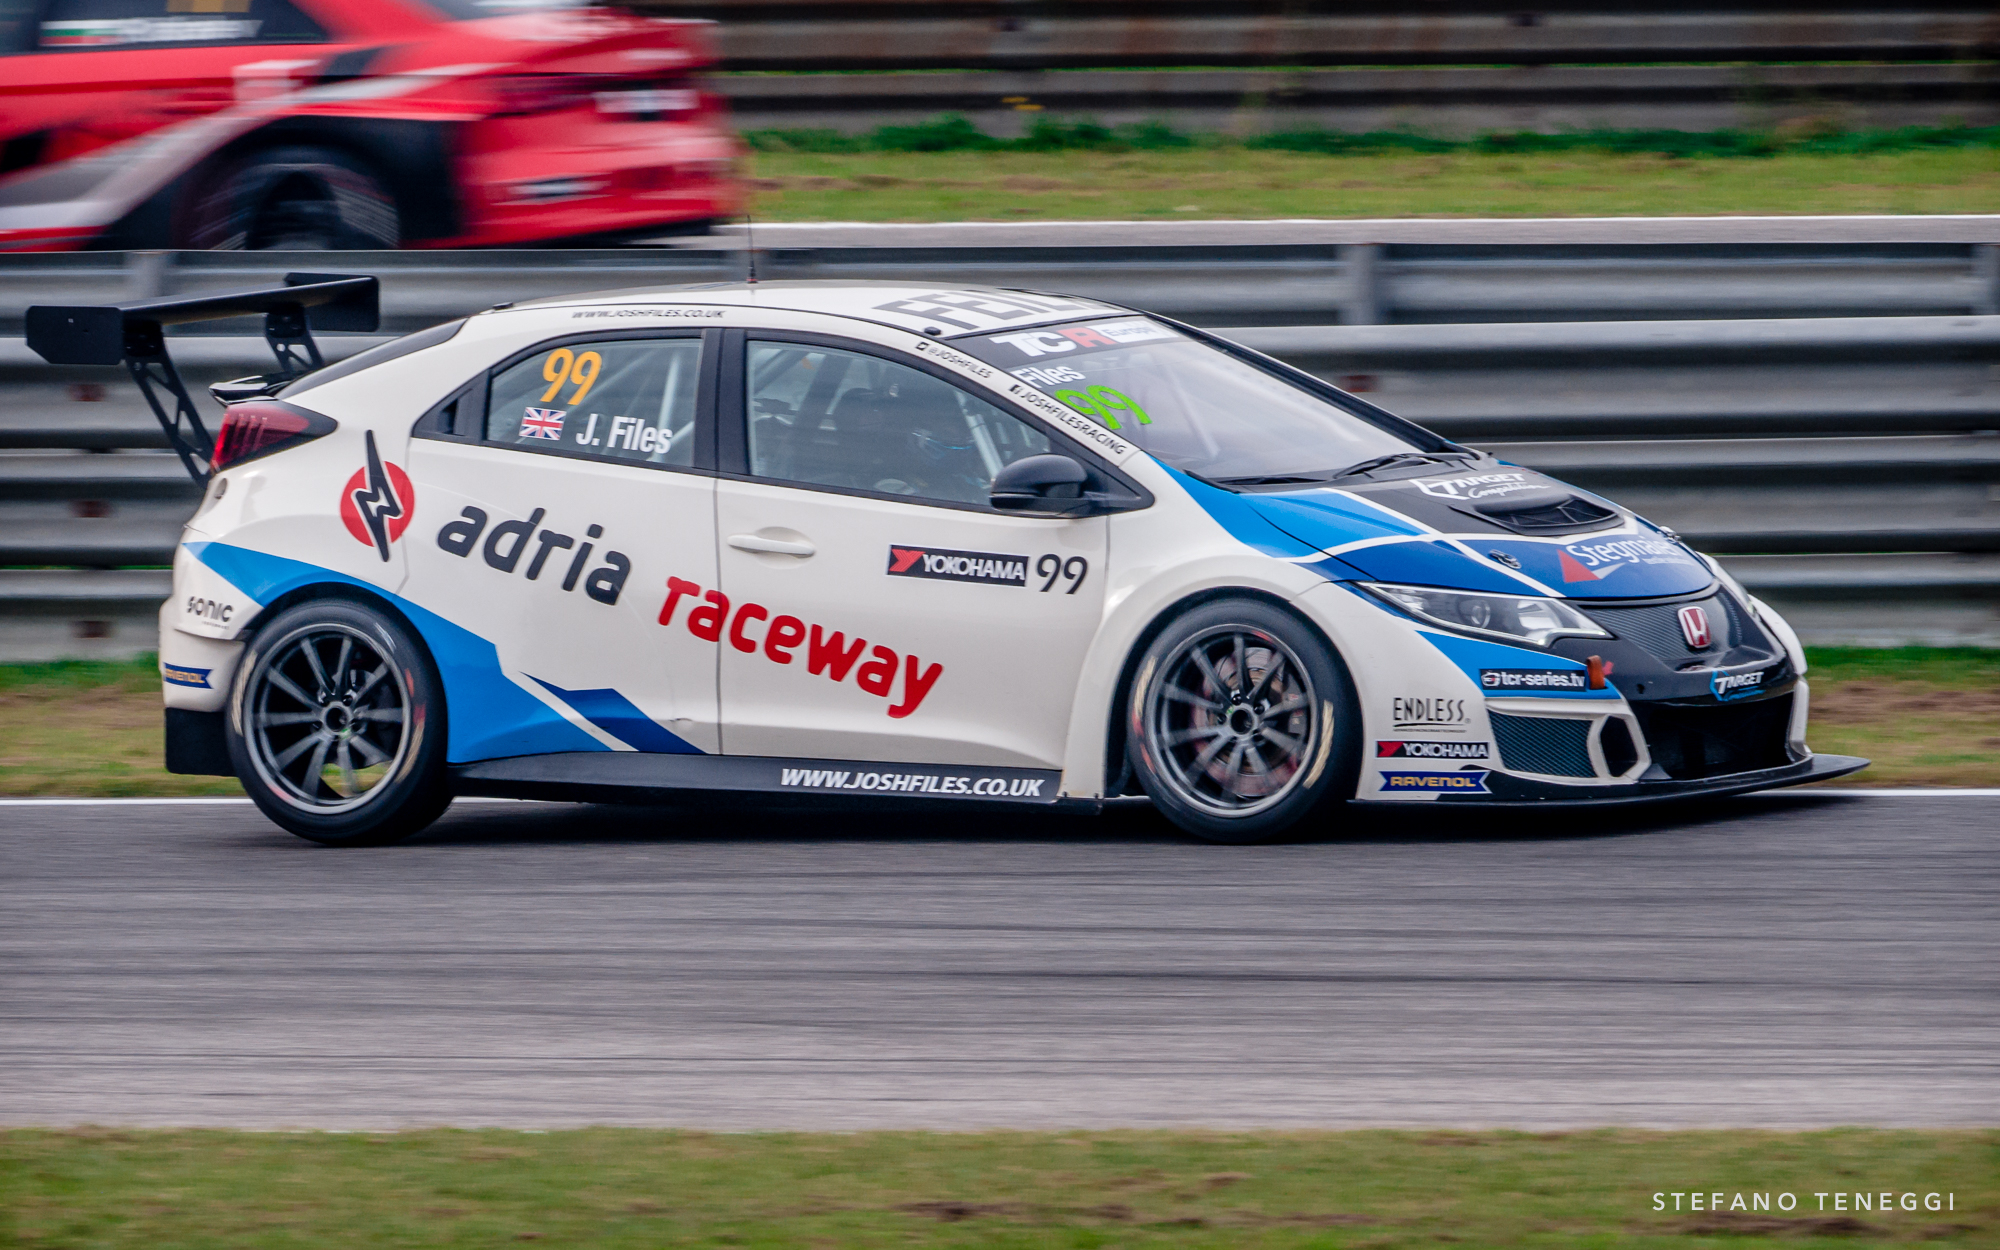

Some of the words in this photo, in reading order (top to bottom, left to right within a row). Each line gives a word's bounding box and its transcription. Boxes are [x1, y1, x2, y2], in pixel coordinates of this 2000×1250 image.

[571, 309, 726, 319] WWW.JOSHFILES.CO.UK
[988, 326, 1118, 357] TCR
[928, 343, 994, 379] @JOSHFILES
[539, 348, 602, 406] 99
[1010, 366, 1086, 390] Files
[1020, 387, 1127, 456] JOSHFILESRACING
[1055, 385, 1152, 431] 99
[575, 413, 600, 446] J.
[607, 416, 673, 454] Files
[1428, 473, 1526, 495] TARGET
[1468, 482, 1551, 499] Competition
[437, 505, 632, 606] adria
[922, 553, 1026, 581] YOKOHAMA
[1036, 553, 1088, 595] 99
[657, 576, 943, 719] raceway
[1501, 671, 1586, 688] tcr-series.tv
[1714, 671, 1765, 695] TARGET
[1392, 697, 1465, 722] ENDLESS
[1403, 743, 1488, 758] YOKOHAMA
[780, 768, 1045, 797] WWW.JOSHFILES.CO.UK
[1390, 776, 1477, 788] RAVENOL
